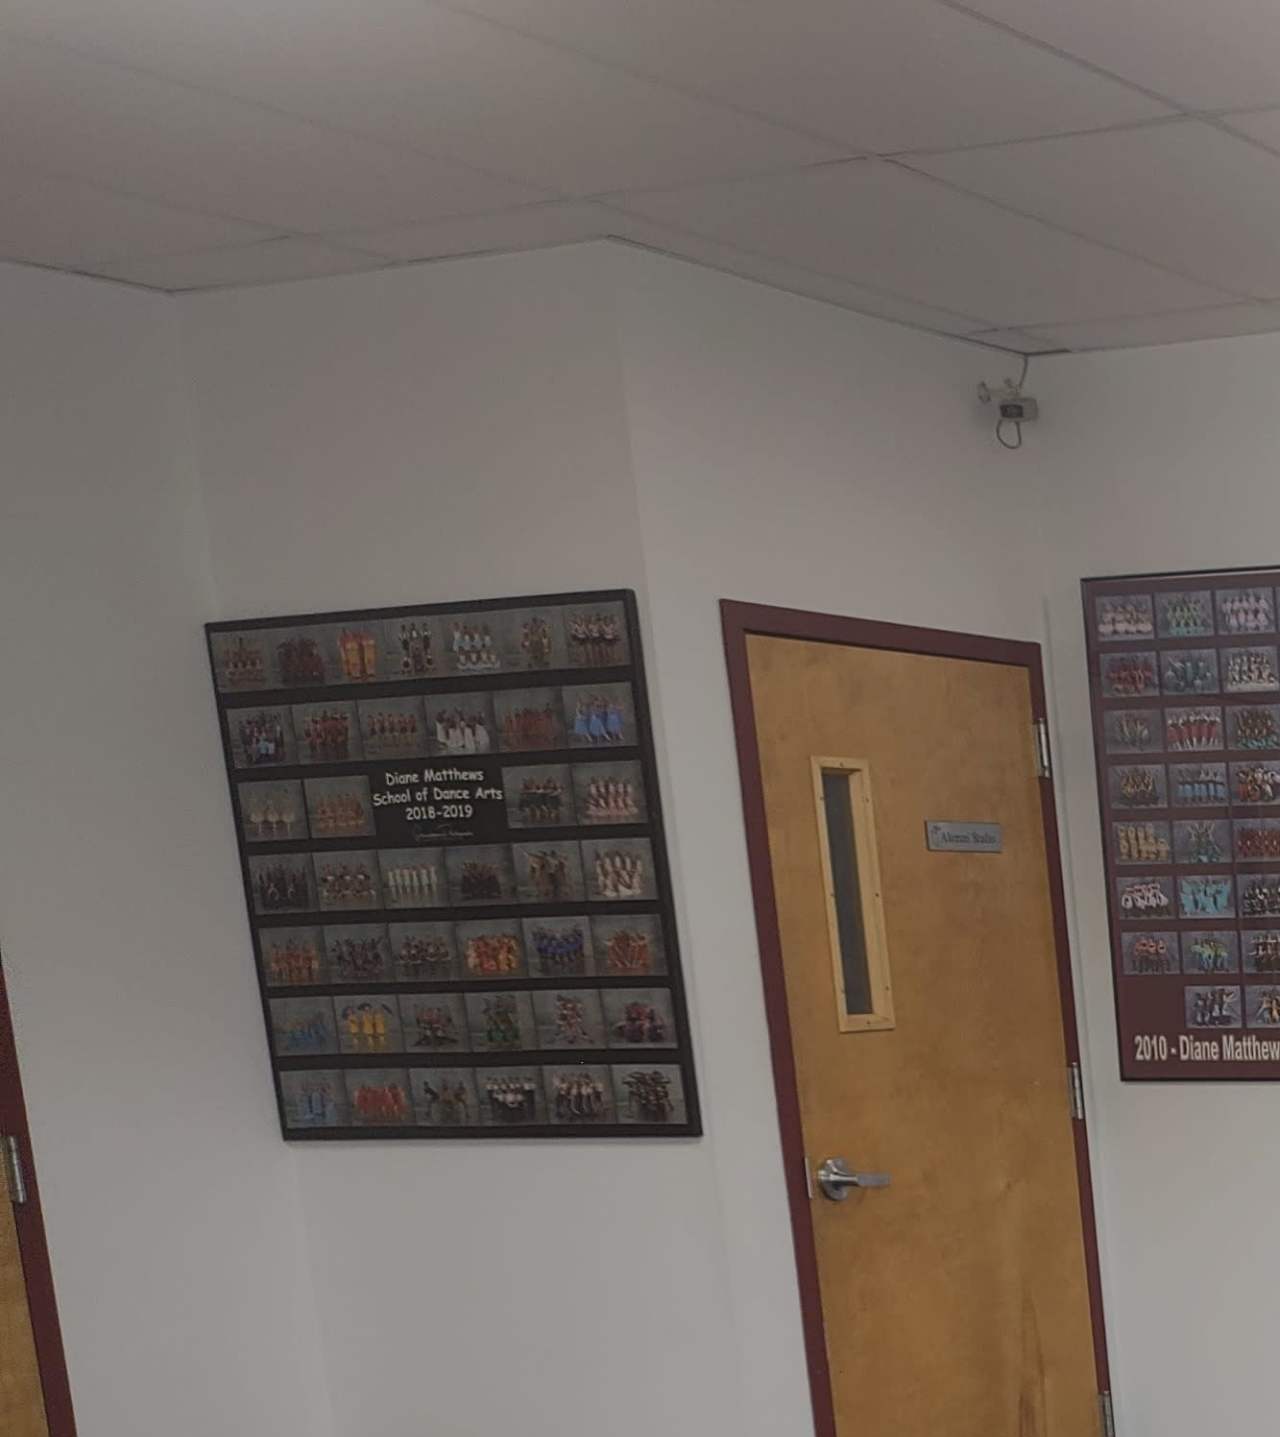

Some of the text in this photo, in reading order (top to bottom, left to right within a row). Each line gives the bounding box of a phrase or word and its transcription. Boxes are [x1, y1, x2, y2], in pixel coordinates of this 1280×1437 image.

[385, 768, 484, 786] Diane Matthews
[373, 787, 503, 806] School of Dance Arts
[405, 804, 473, 820] 2018-2019
[1134, 1034, 1167, 1061] 2010
[1179, 1034, 1219, 1061] Diane
